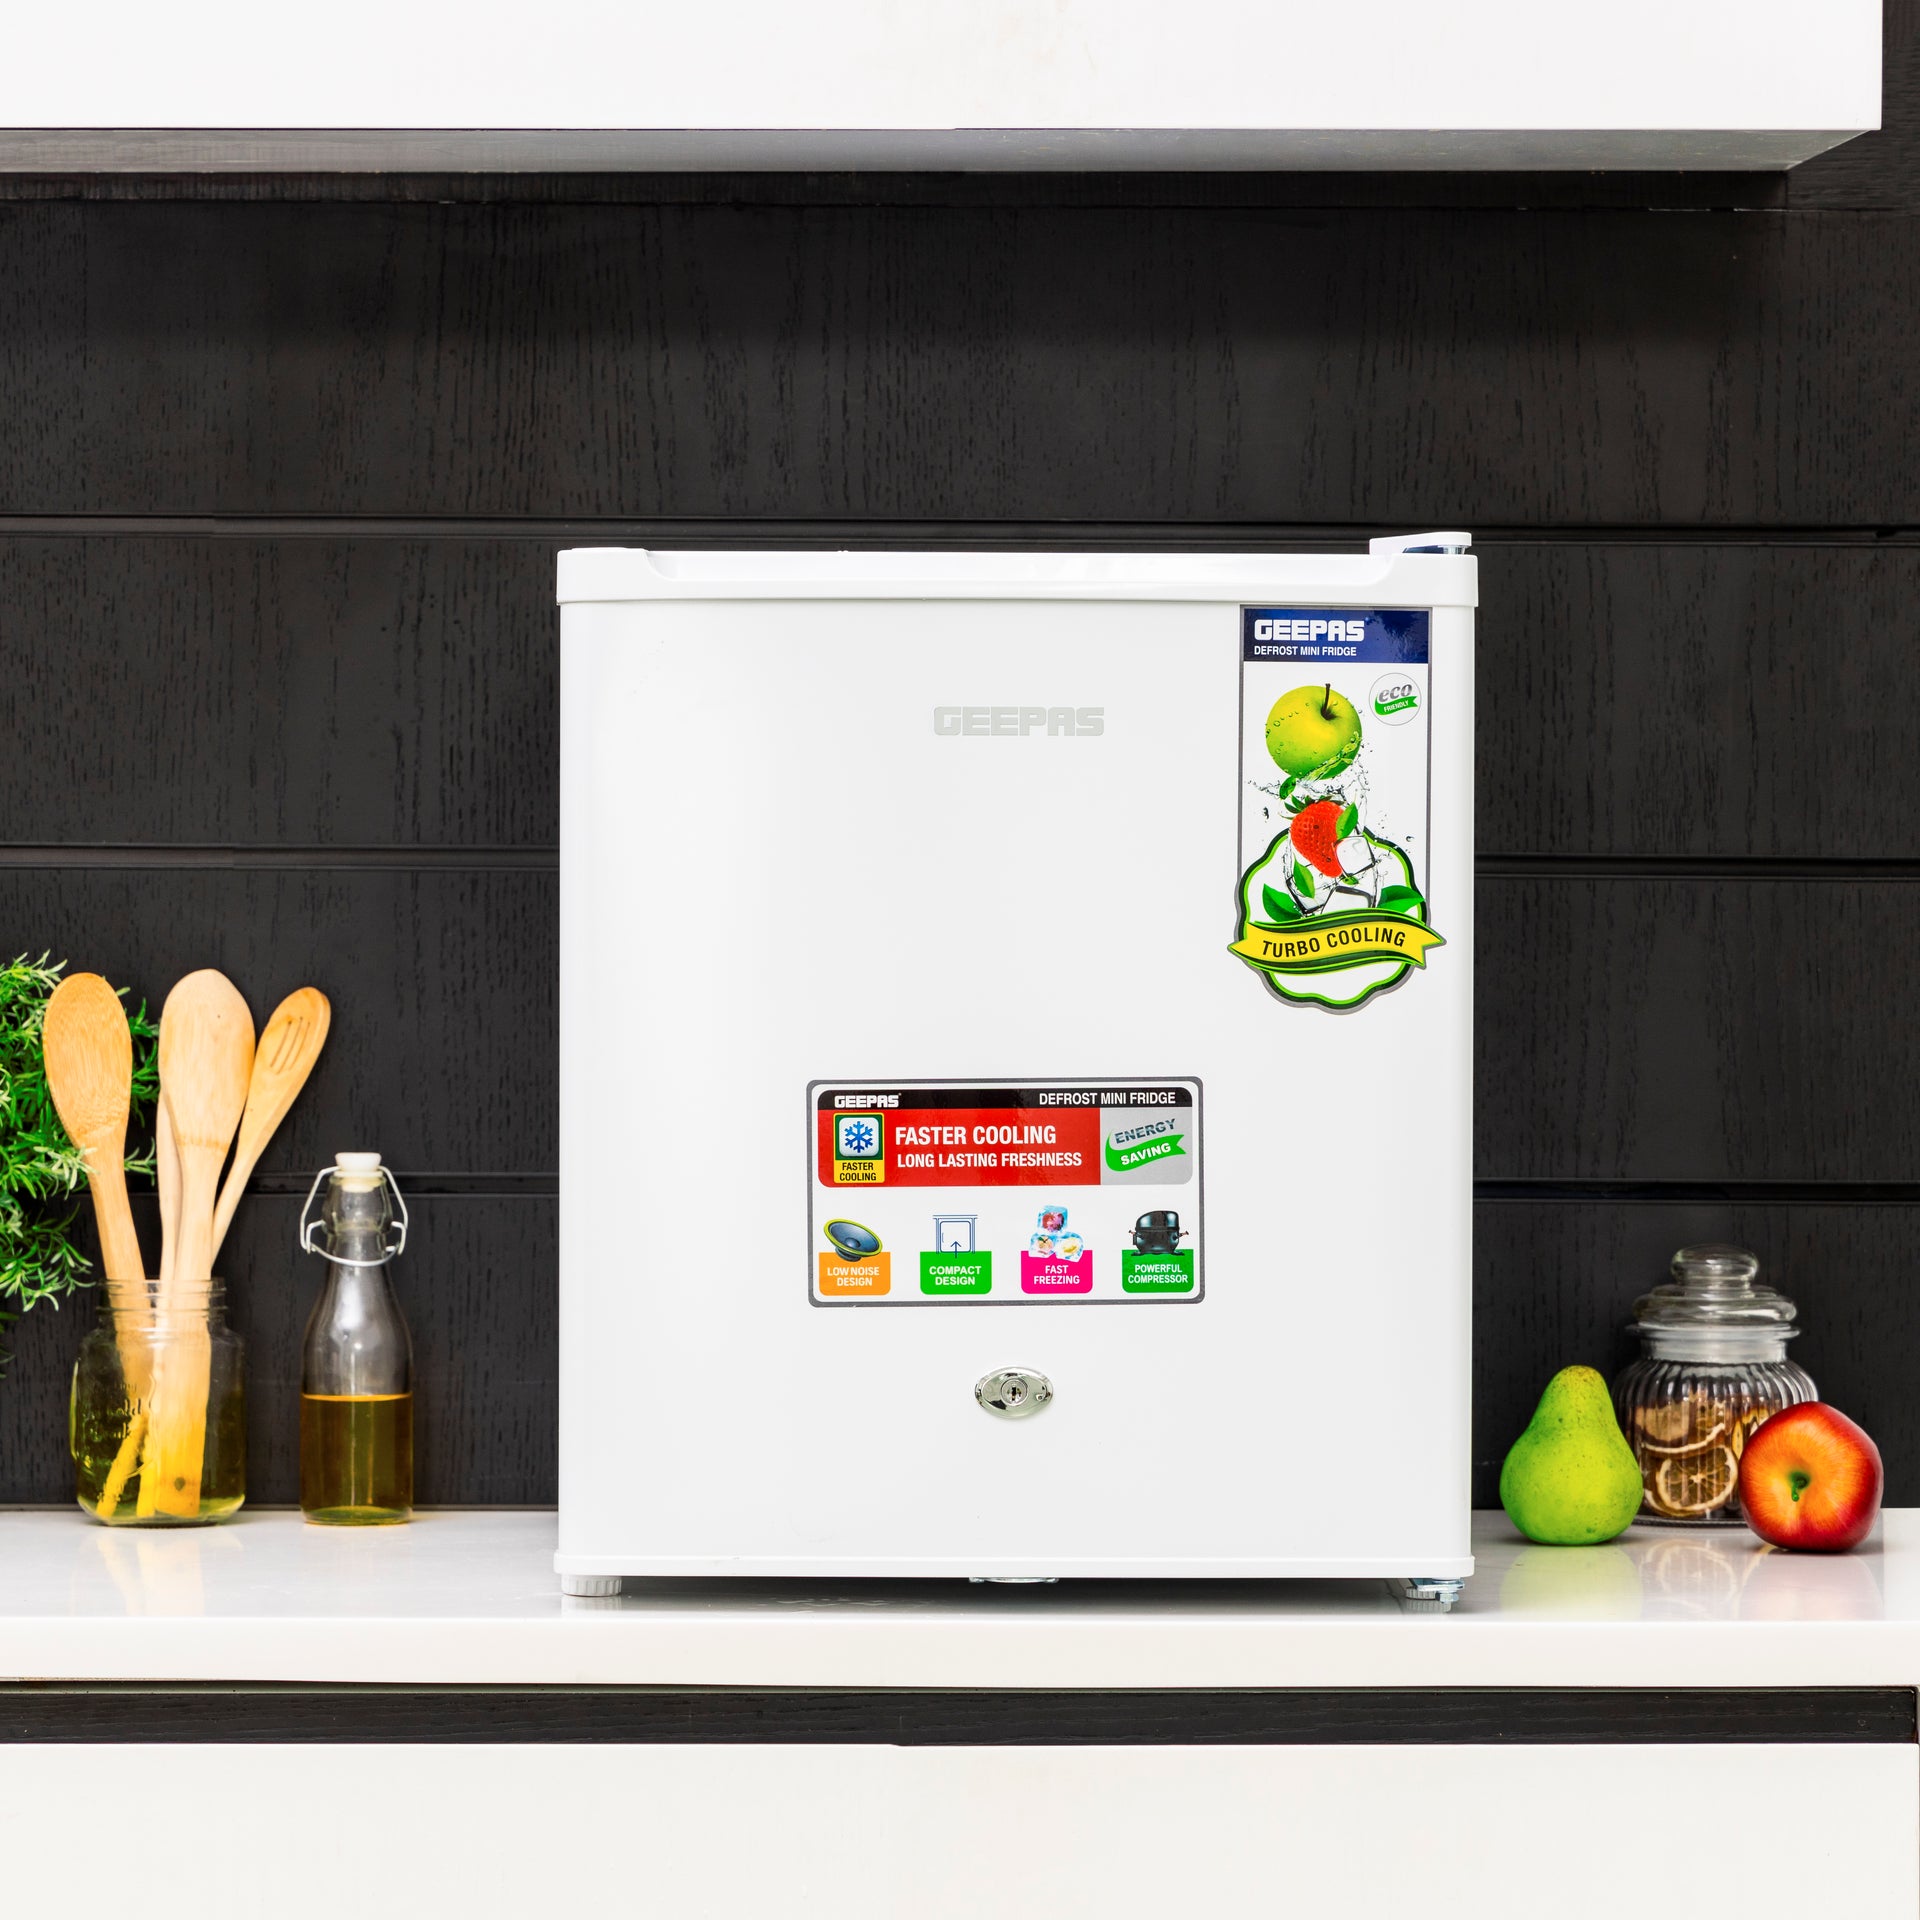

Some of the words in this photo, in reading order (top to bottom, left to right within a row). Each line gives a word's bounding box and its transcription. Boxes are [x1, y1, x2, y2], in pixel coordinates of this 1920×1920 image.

[1254, 619, 1365, 642] GEEPAS
[1254, 645, 1298, 656] DEFROST
[1300, 646, 1320, 656] MINI
[1321, 646, 1357, 657] FRIDGE
[1378, 683, 1413, 702] eco
[1383, 700, 1409, 713] FRIENDLY
[933, 706, 1105, 737] GEEPAS
[1262, 937, 1321, 958] TURBO
[1326, 927, 1406, 948] COOLING
[834, 1095, 899, 1108] GEEPAS
[1039, 1092, 1098, 1105] DEFROST
[1101, 1092, 1126, 1104] MINI
[1129, 1092, 1176, 1104] FRIDGE
[895, 1126, 967, 1145] FASTER
[972, 1125, 1056, 1145] COOLING
[1114, 1118, 1176, 1144] ENERGY
[897, 1154, 934, 1168] LONG
[938, 1153, 997, 1168] LASTING
[1001, 1152, 1082, 1167] FRESHNESS
[1120, 1142, 1172, 1166] SAVING
[842, 1162, 874, 1171] FASTER
[839, 1172, 877, 1182] COOLING
[827, 1267, 849, 1276] LOW
[850, 1267, 880, 1276] NOISE
[929, 1266, 982, 1275] COMPACT
[1045, 1265, 1069, 1274] FAST
[1134, 1264, 1183, 1273] POWERFUL
[836, 1277, 873, 1287] DESIGN
[935, 1276, 976, 1286] DESIGN
[1033, 1275, 1080, 1285] FREEZING
[1128, 1274, 1189, 1284] COMPRESSOR
